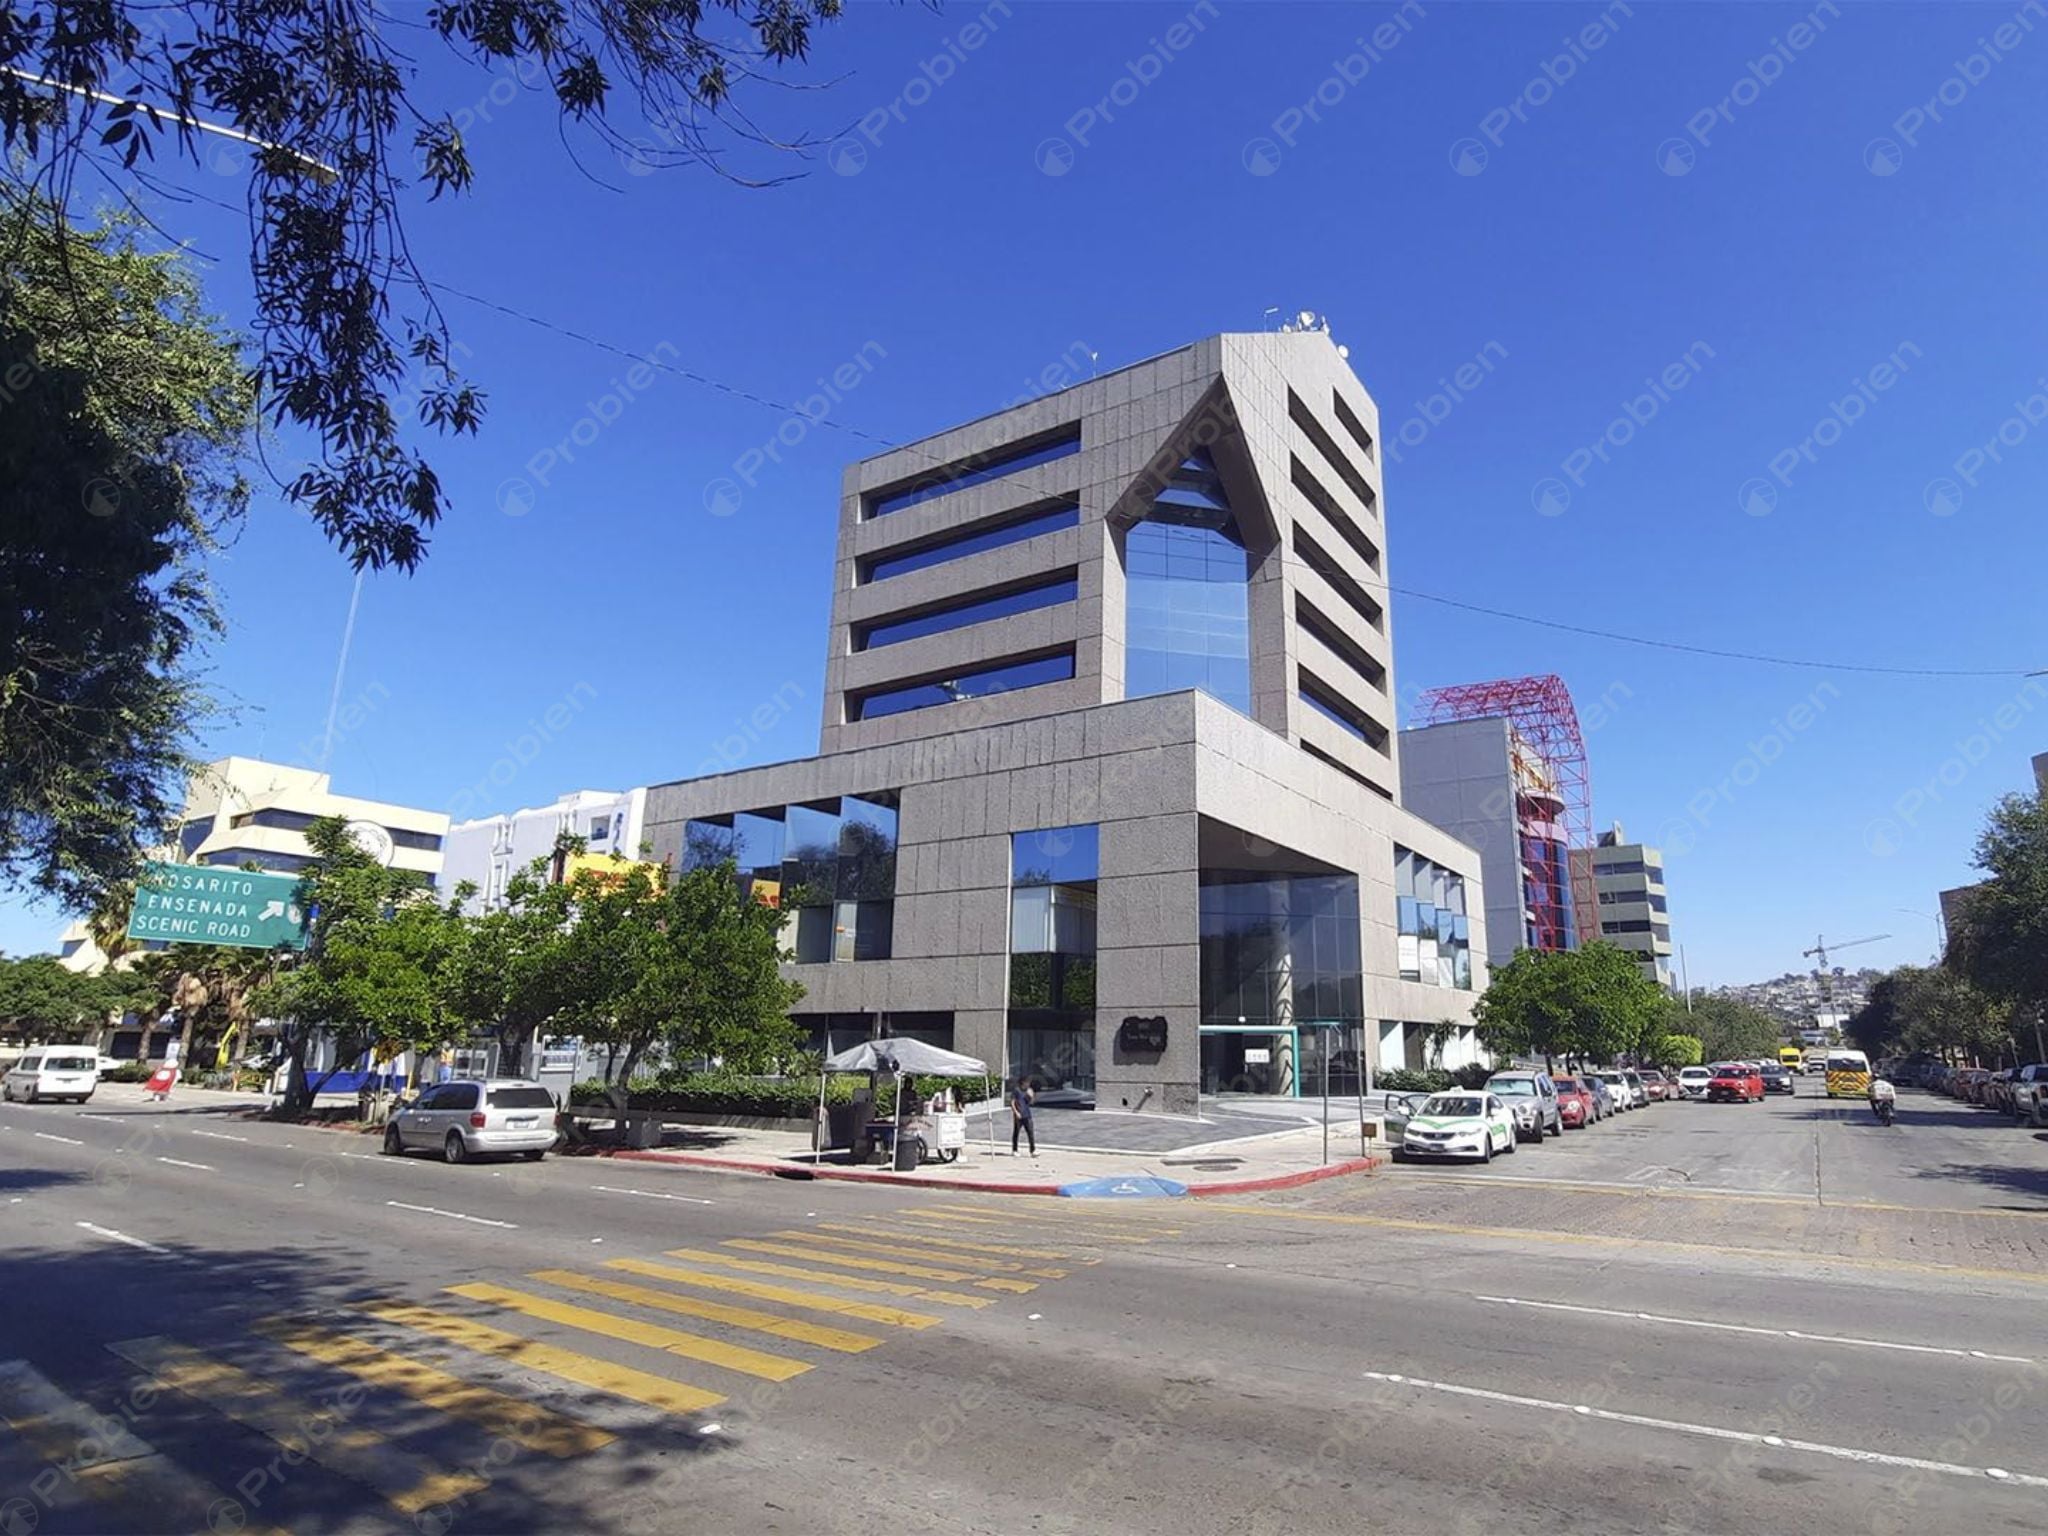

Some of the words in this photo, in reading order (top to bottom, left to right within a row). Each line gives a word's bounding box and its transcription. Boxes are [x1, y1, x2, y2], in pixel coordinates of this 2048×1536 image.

[148, 894, 248, 918] ENSENADA
[136, 915, 199, 934] SCENIC
[207, 921, 251, 938] ROAD
